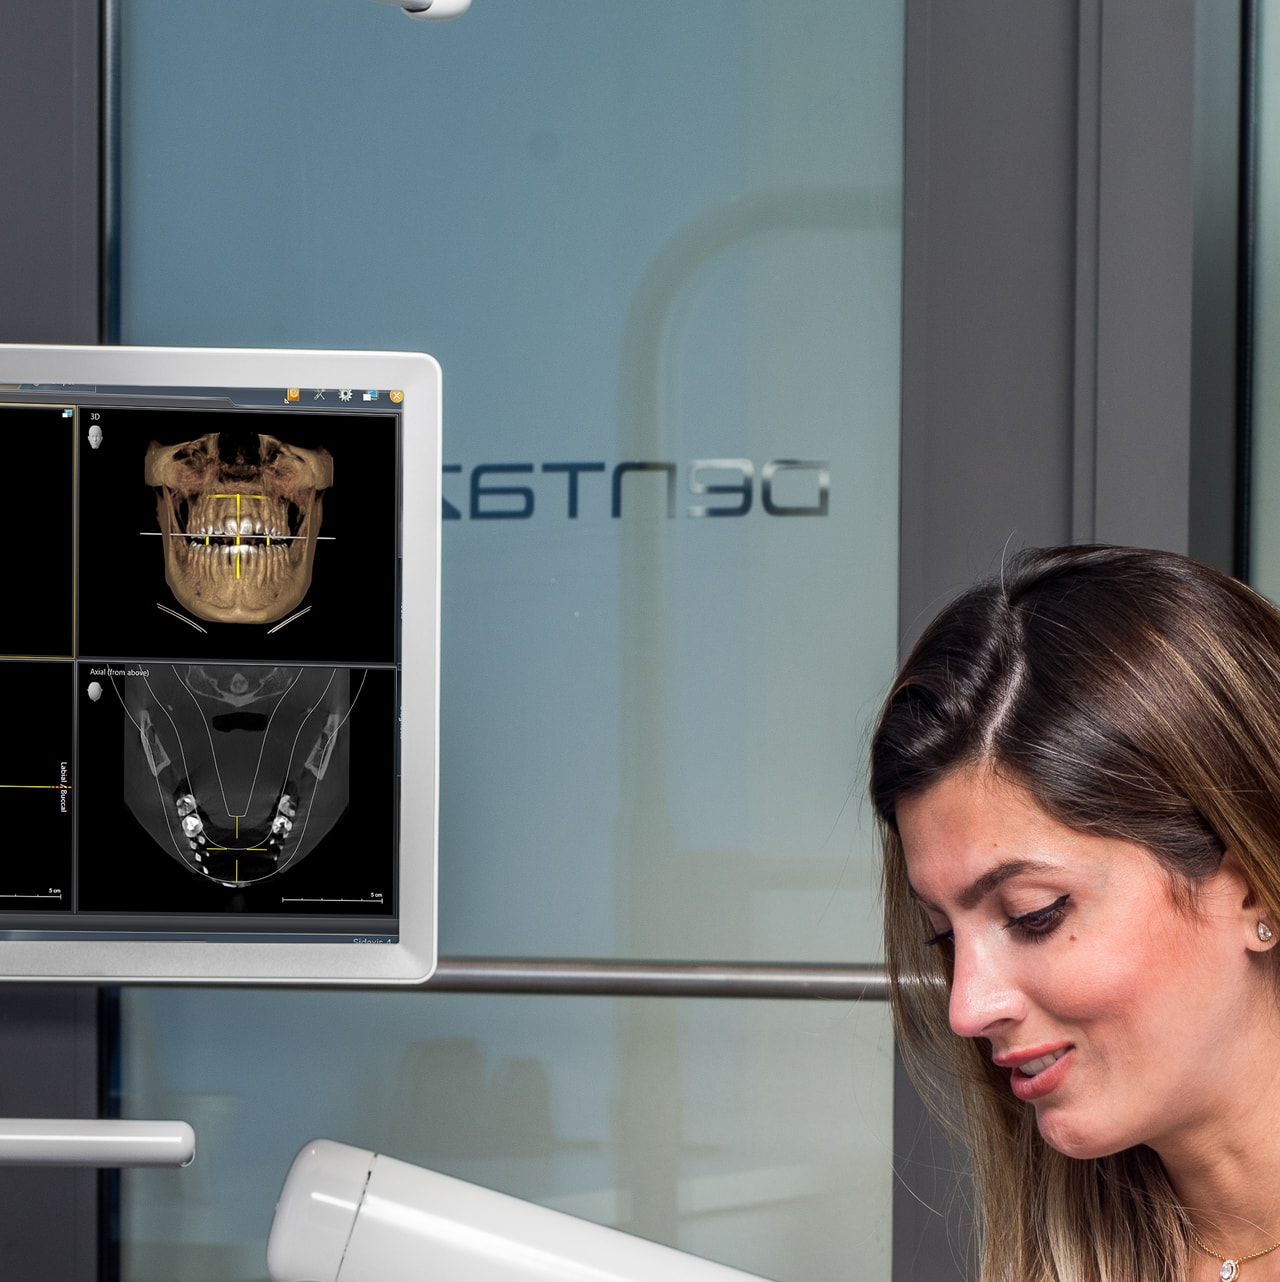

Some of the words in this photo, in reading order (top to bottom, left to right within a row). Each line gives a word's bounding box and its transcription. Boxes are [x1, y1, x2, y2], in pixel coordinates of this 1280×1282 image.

[90, 412, 100, 420] 3D
[90, 668, 106, 676] Axial
[107, 668, 126, 677] (from
[126, 669, 150, 677] above)
[60, 761, 68, 783] Labial
[60, 789, 68, 813] Buccal
